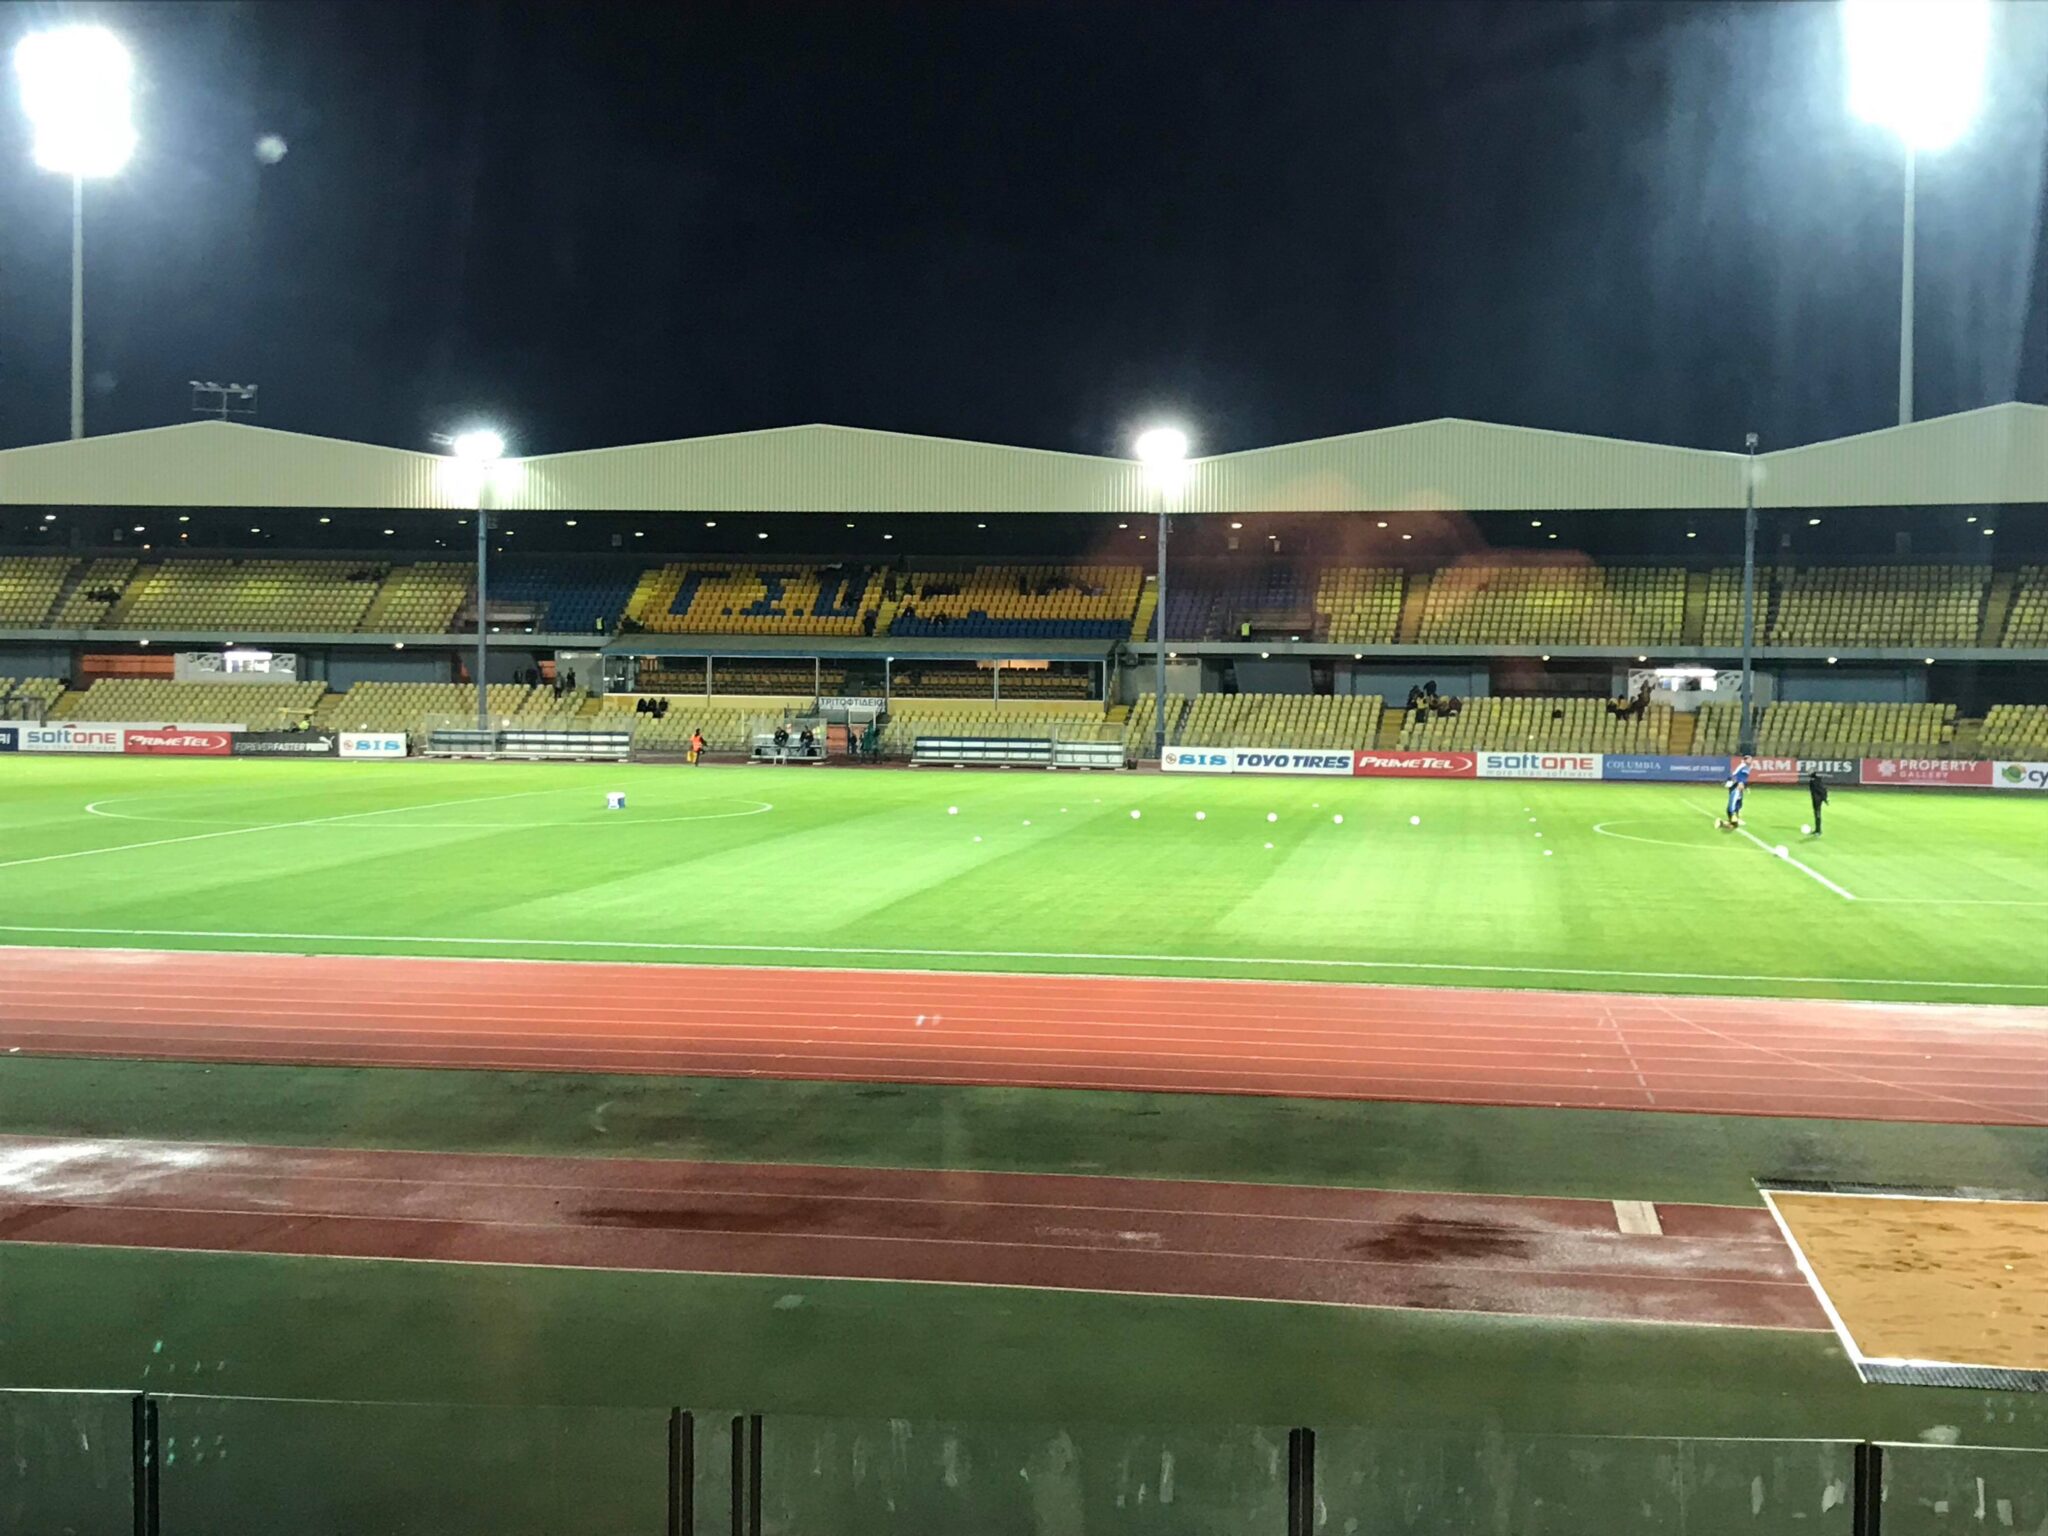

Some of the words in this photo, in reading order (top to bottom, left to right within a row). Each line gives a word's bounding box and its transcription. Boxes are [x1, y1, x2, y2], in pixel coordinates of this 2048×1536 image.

[355, 740, 400, 751] SIS
[1178, 754, 1227, 766] SIS
[1237, 754, 1289, 767] TOYO
[1293, 755, 1351, 769] TIRES
[1606, 761, 1661, 769] COLUMBIA
[1900, 760, 1978, 771] PROPERTY
[1741, 759, 1792, 771] ARM
[1797, 760, 1852, 773] FRITES
